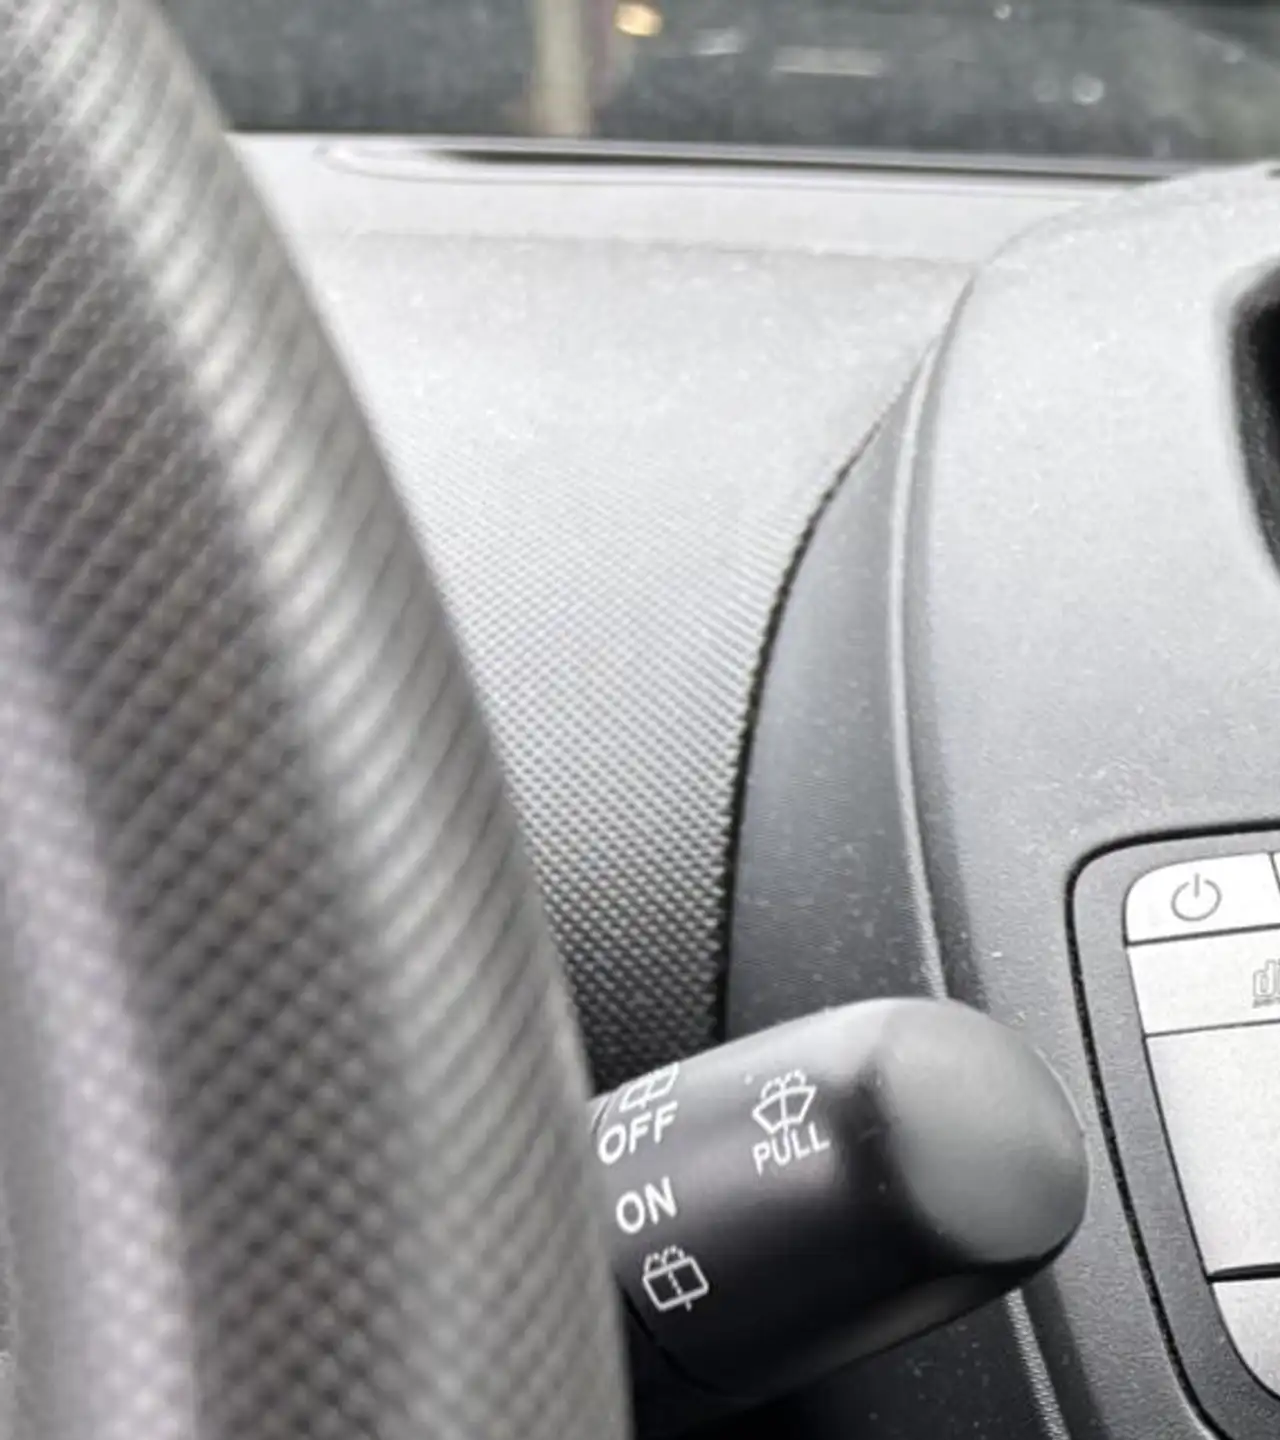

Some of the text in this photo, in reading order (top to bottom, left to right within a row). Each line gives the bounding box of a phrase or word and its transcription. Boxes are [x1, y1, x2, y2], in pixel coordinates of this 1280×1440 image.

[597, 1101, 679, 1164] OFF
[752, 1122, 832, 1175] PULL
[615, 1177, 679, 1234] ON
